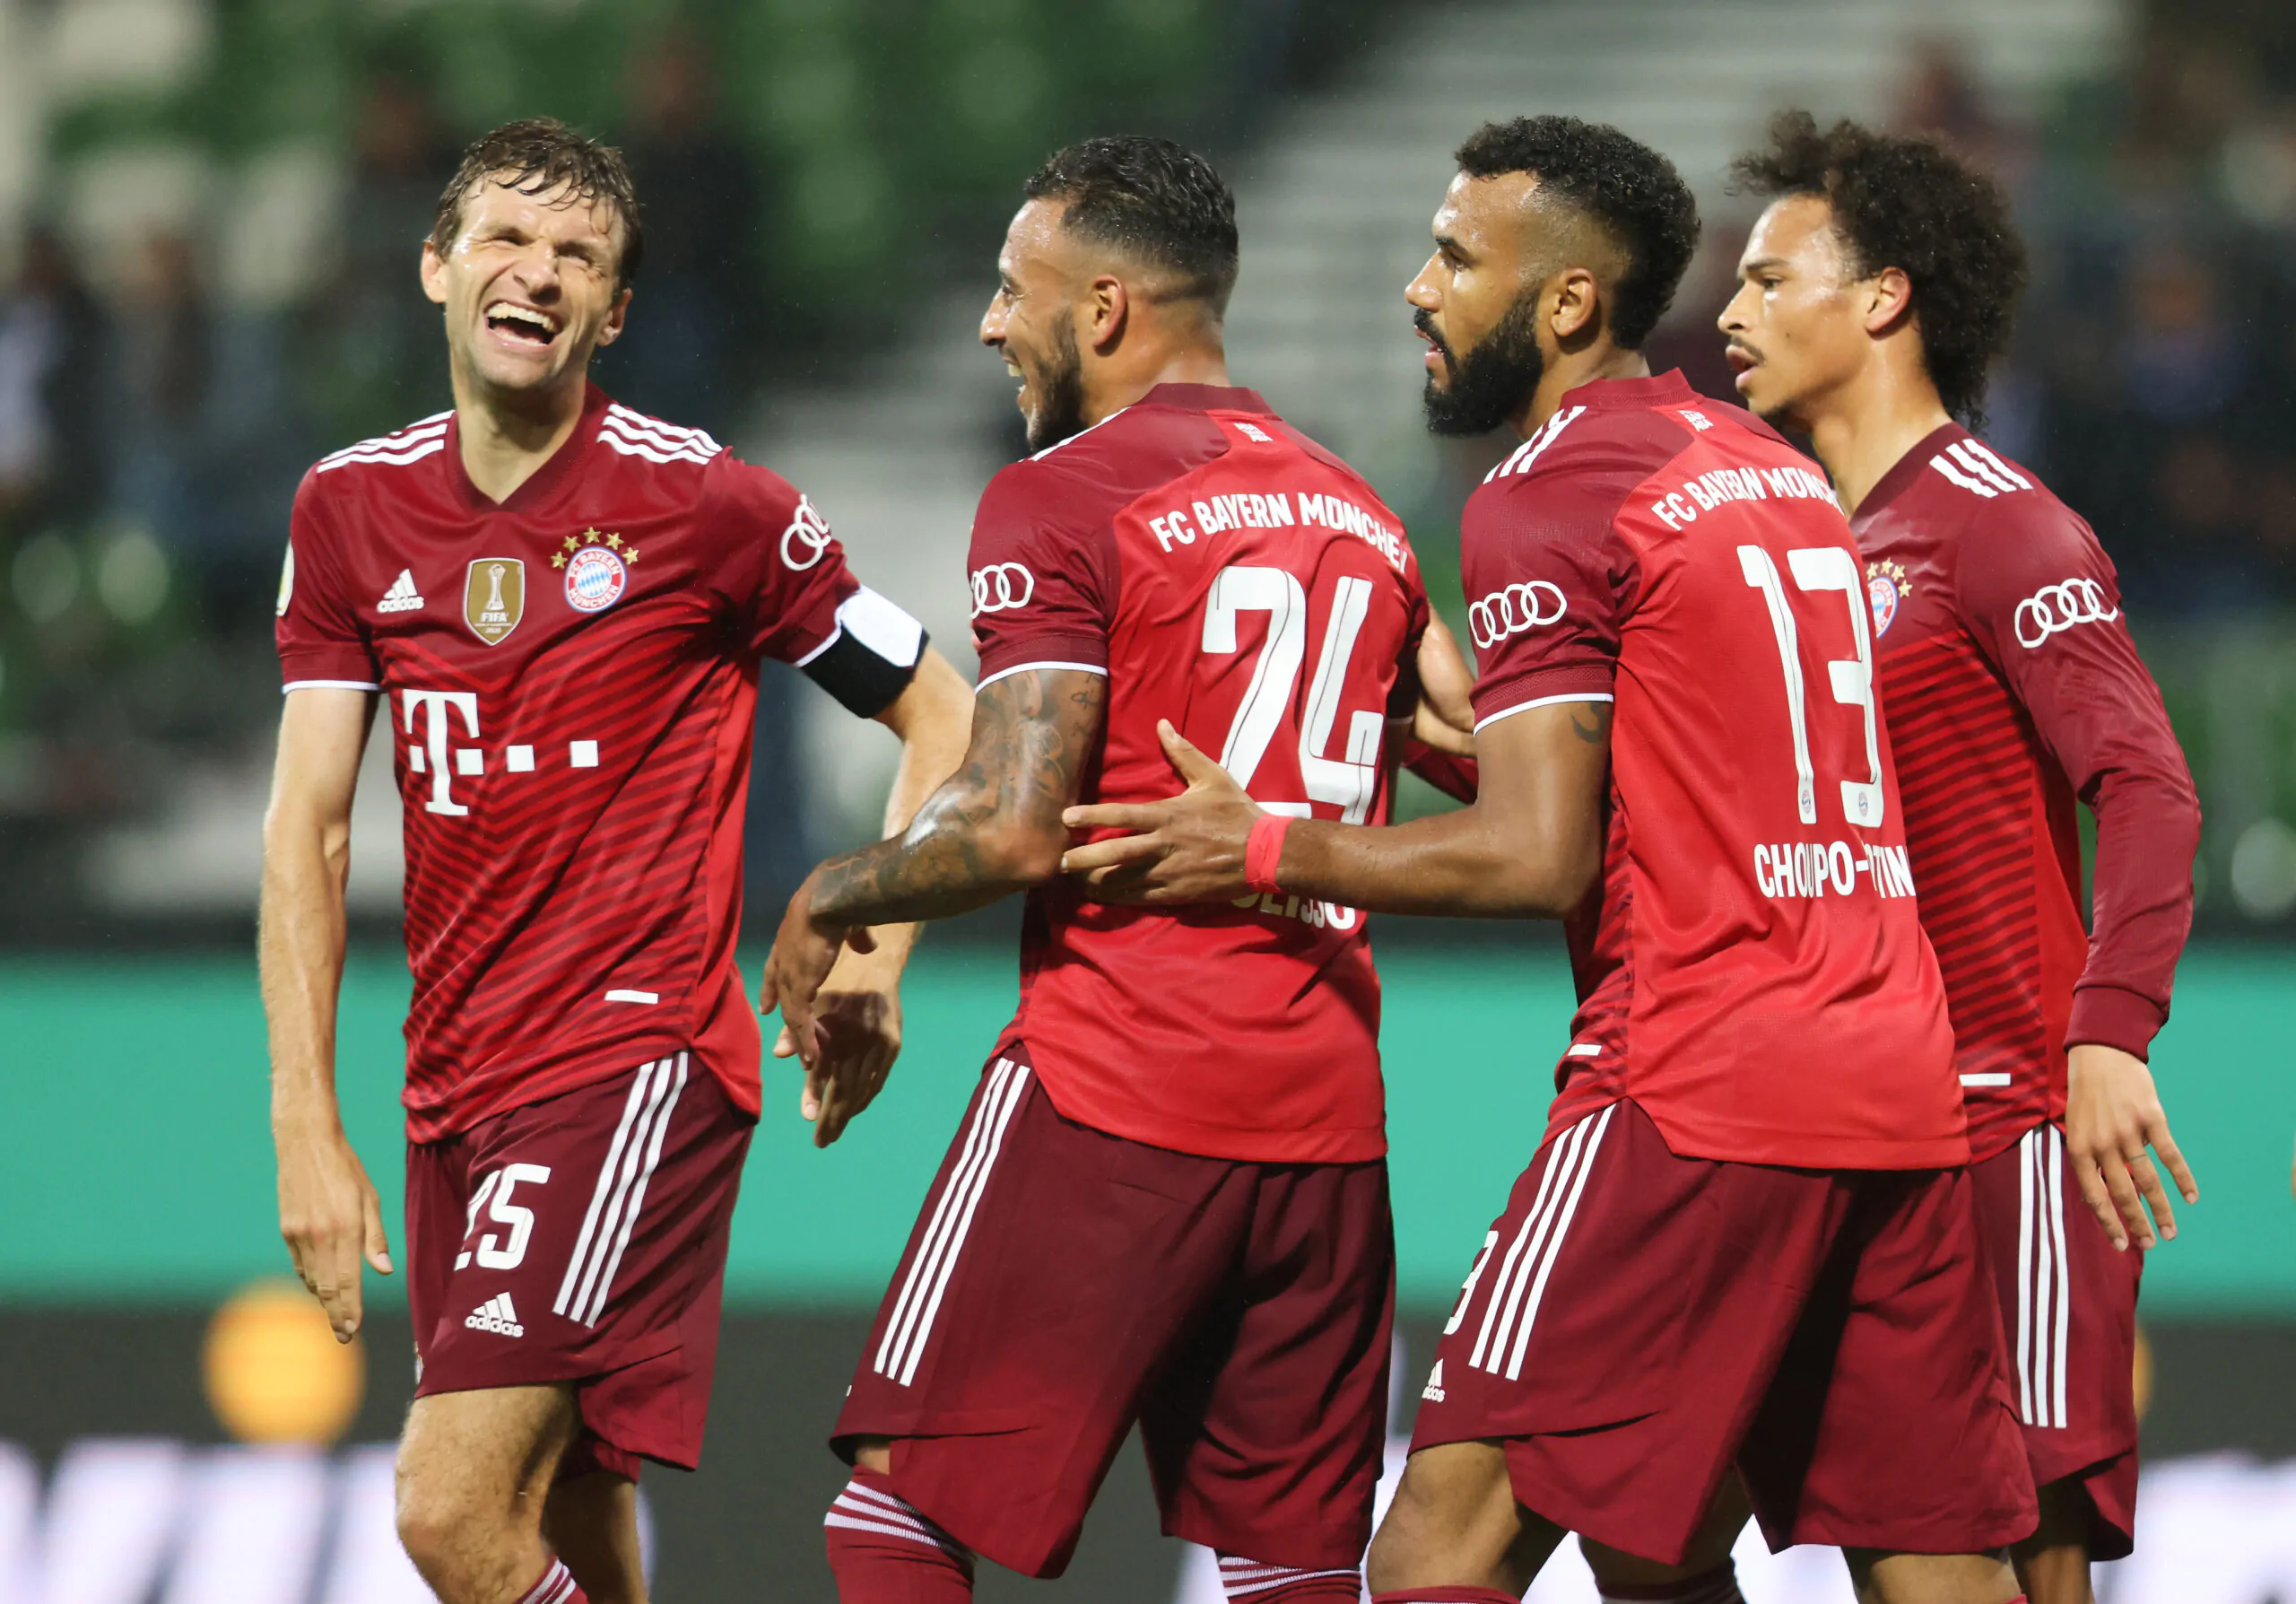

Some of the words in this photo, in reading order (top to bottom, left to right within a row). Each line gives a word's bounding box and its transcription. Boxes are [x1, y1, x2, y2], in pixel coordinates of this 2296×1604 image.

[1149, 510, 1196, 553] FC
[1192, 493, 1295, 536] BAYERN
[1651, 492, 1697, 531] FC
[1683, 467, 1767, 511] BAYERN
[568, 562, 581, 578] FC
[579, 551, 622, 575] BAYERN
[377, 597, 424, 614] adidas
[480, 612, 508, 623] FIFA
[1202, 565, 1385, 826] 24
[1736, 544, 1884, 829] 13
[1442, 1230, 1500, 1336] 3
[464, 1314, 525, 1338] adidas
